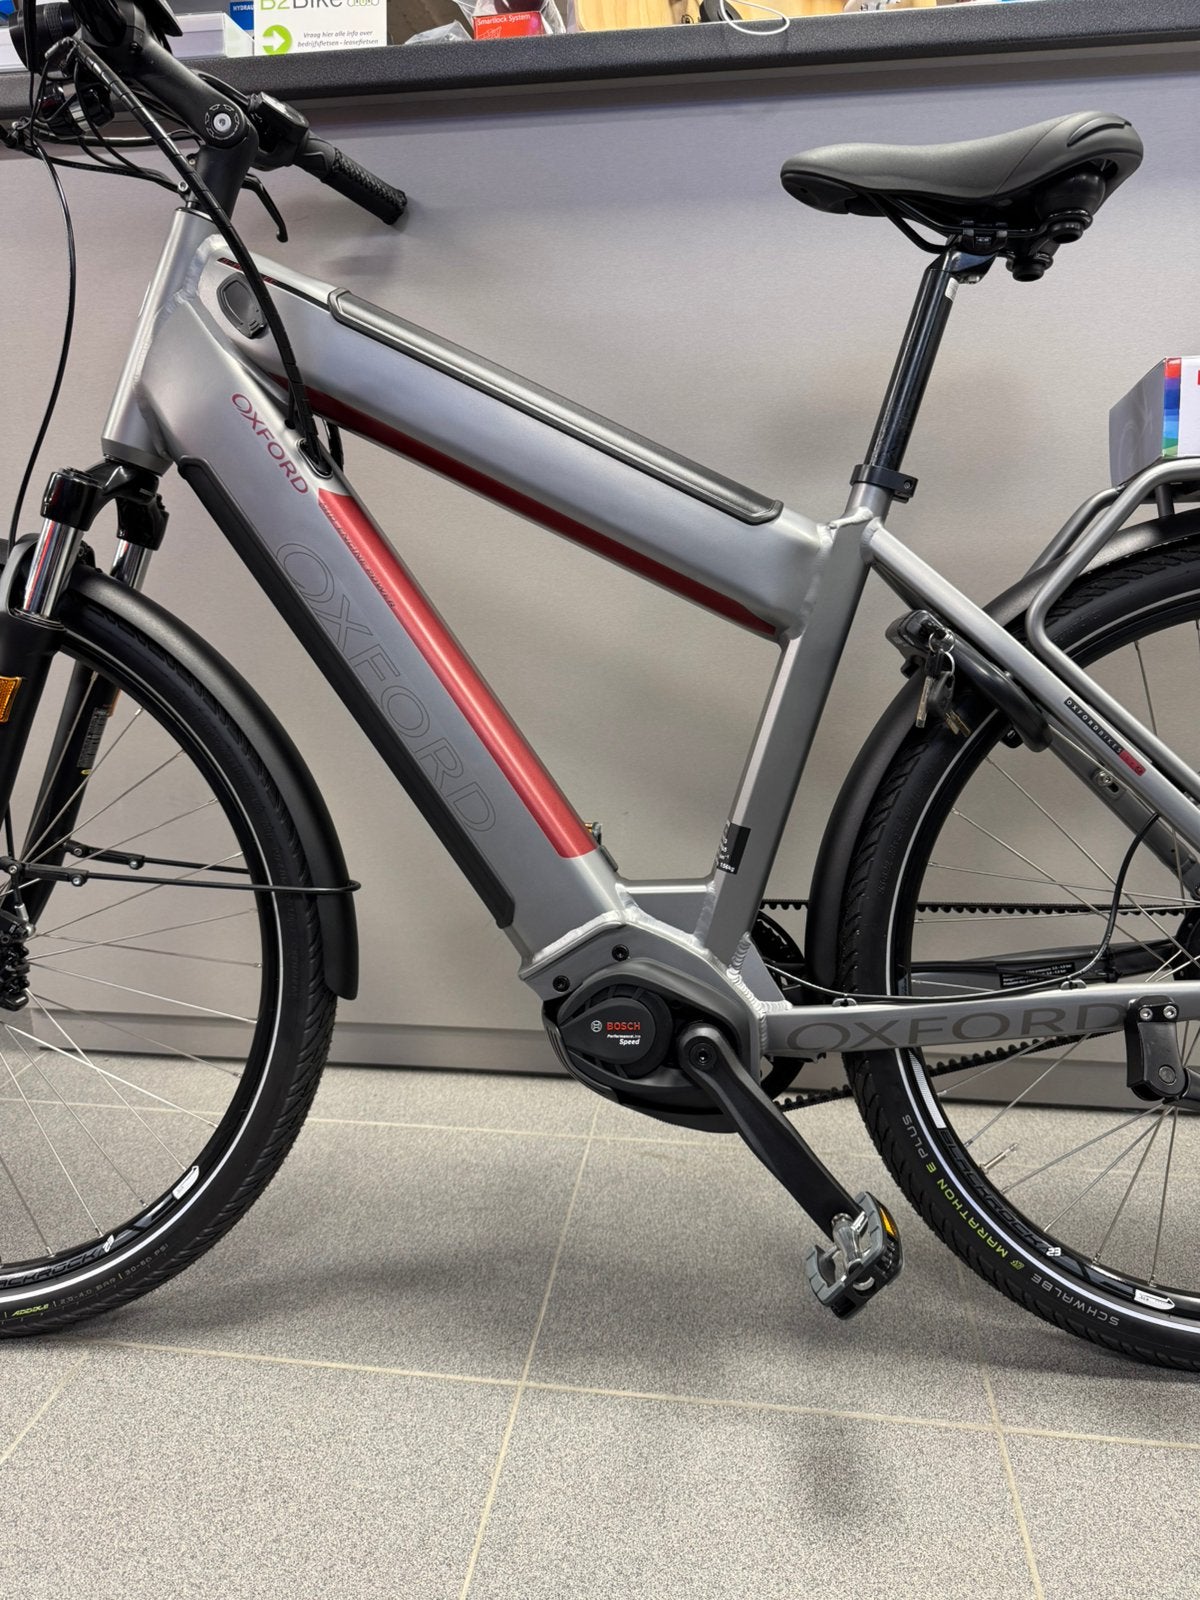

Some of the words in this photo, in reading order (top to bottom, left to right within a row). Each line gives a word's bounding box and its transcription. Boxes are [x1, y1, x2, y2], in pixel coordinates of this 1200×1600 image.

[346, 30, 358, 38] info
[477, 16, 507, 26] Smartlock
[508, 14, 531, 23] System
[231, 393, 309, 494] OXFORD
[275, 543, 496, 832] OXFORD
[606, 1021, 641, 1031] BOSCH
[786, 1002, 1126, 1052] OXFORD
[619, 1038, 640, 1046] Speed
[902, 1113, 928, 1159] PLUS
[926, 1161, 937, 1173] E
[936, 1178, 1009, 1258] MARATHON
[1046, 1246, 1062, 1257] 23
[1031, 1273, 1120, 1327] SCHWALBE
